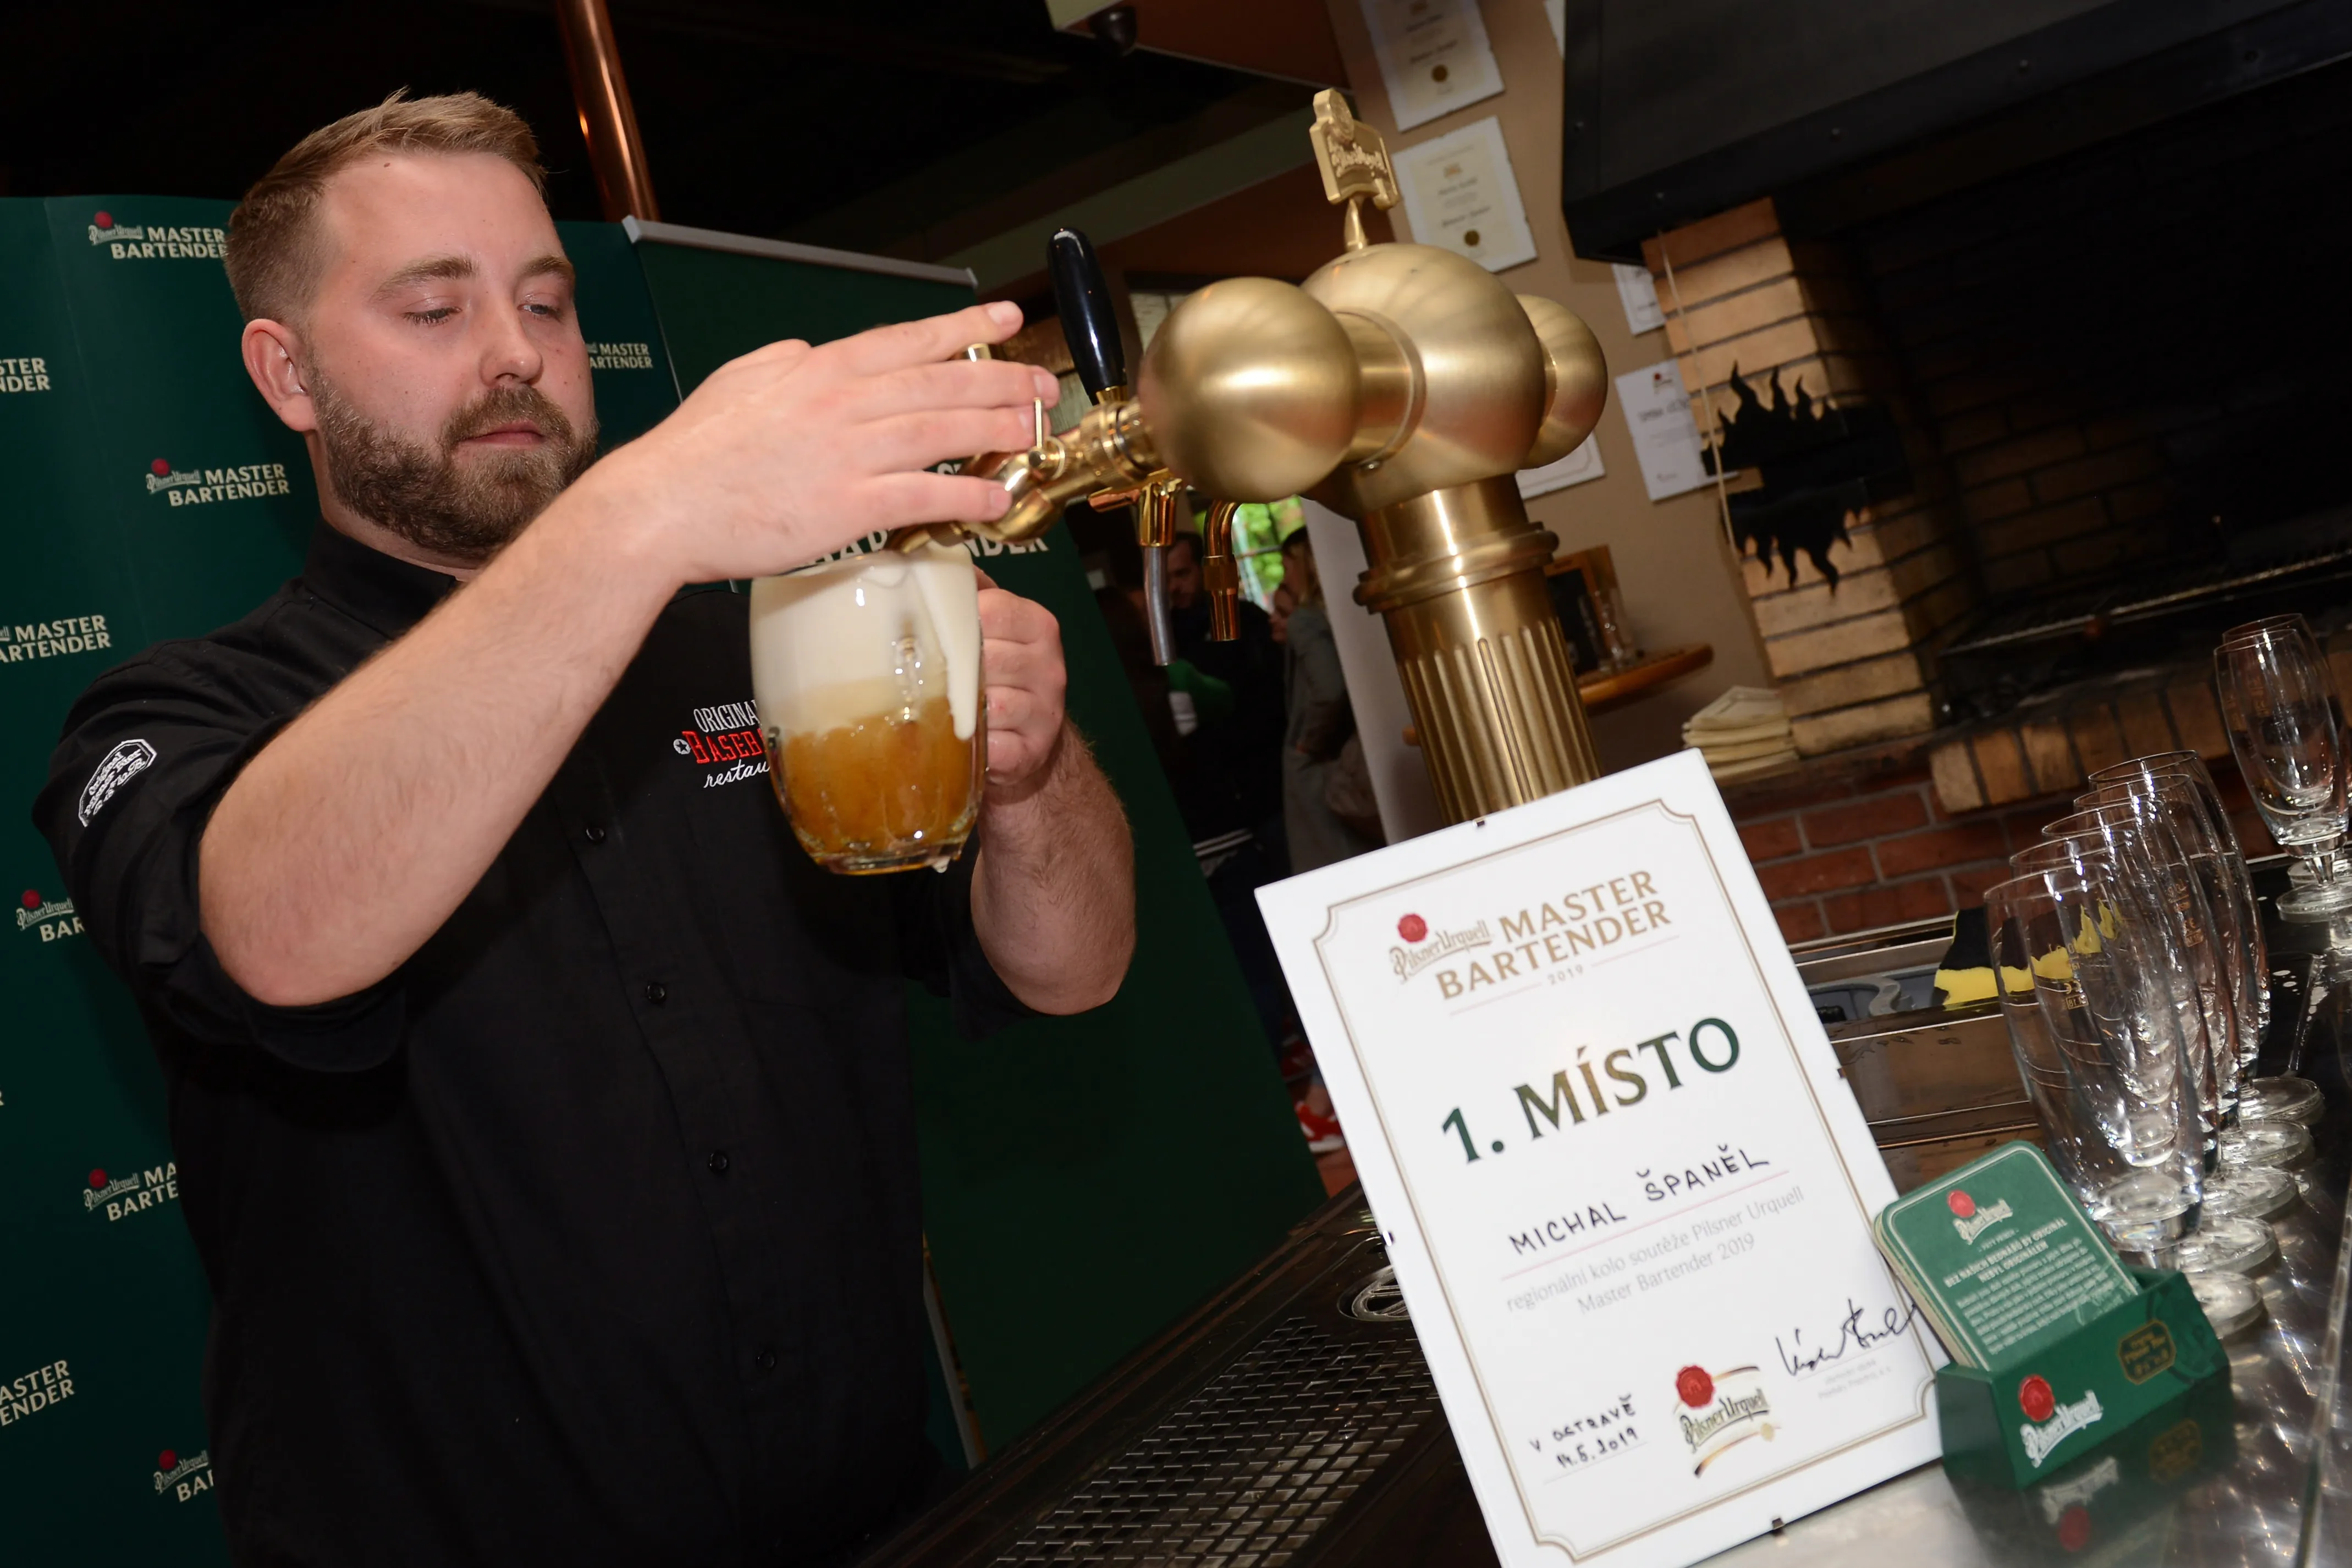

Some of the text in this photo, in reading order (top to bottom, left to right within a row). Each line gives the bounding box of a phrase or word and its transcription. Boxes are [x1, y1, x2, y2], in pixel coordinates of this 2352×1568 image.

[147, 227, 225, 243] MASTER
[599, 343, 649, 356] MASTER
[205, 463, 286, 485] MASTER
[168, 479, 290, 507] BARTENDER
[15, 615, 107, 643] MASTER
[682, 727, 767, 764] BASEB
[1499, 869, 1658, 943] MASTER
[1434, 899, 1672, 1000] BARTENDER
[1547, 964, 1584, 986] 2019
[1441, 1017, 1740, 1164] 1. MÍSTO
[1507, 1144, 1770, 1256] MICHAL ŠPANĚL
[1506, 1185, 1806, 1312] regionální kolo soutěže Pilsner Urquell
[1577, 1233, 1756, 1315] Master Bartender 2019
[1529, 1438, 1541, 1453] V
